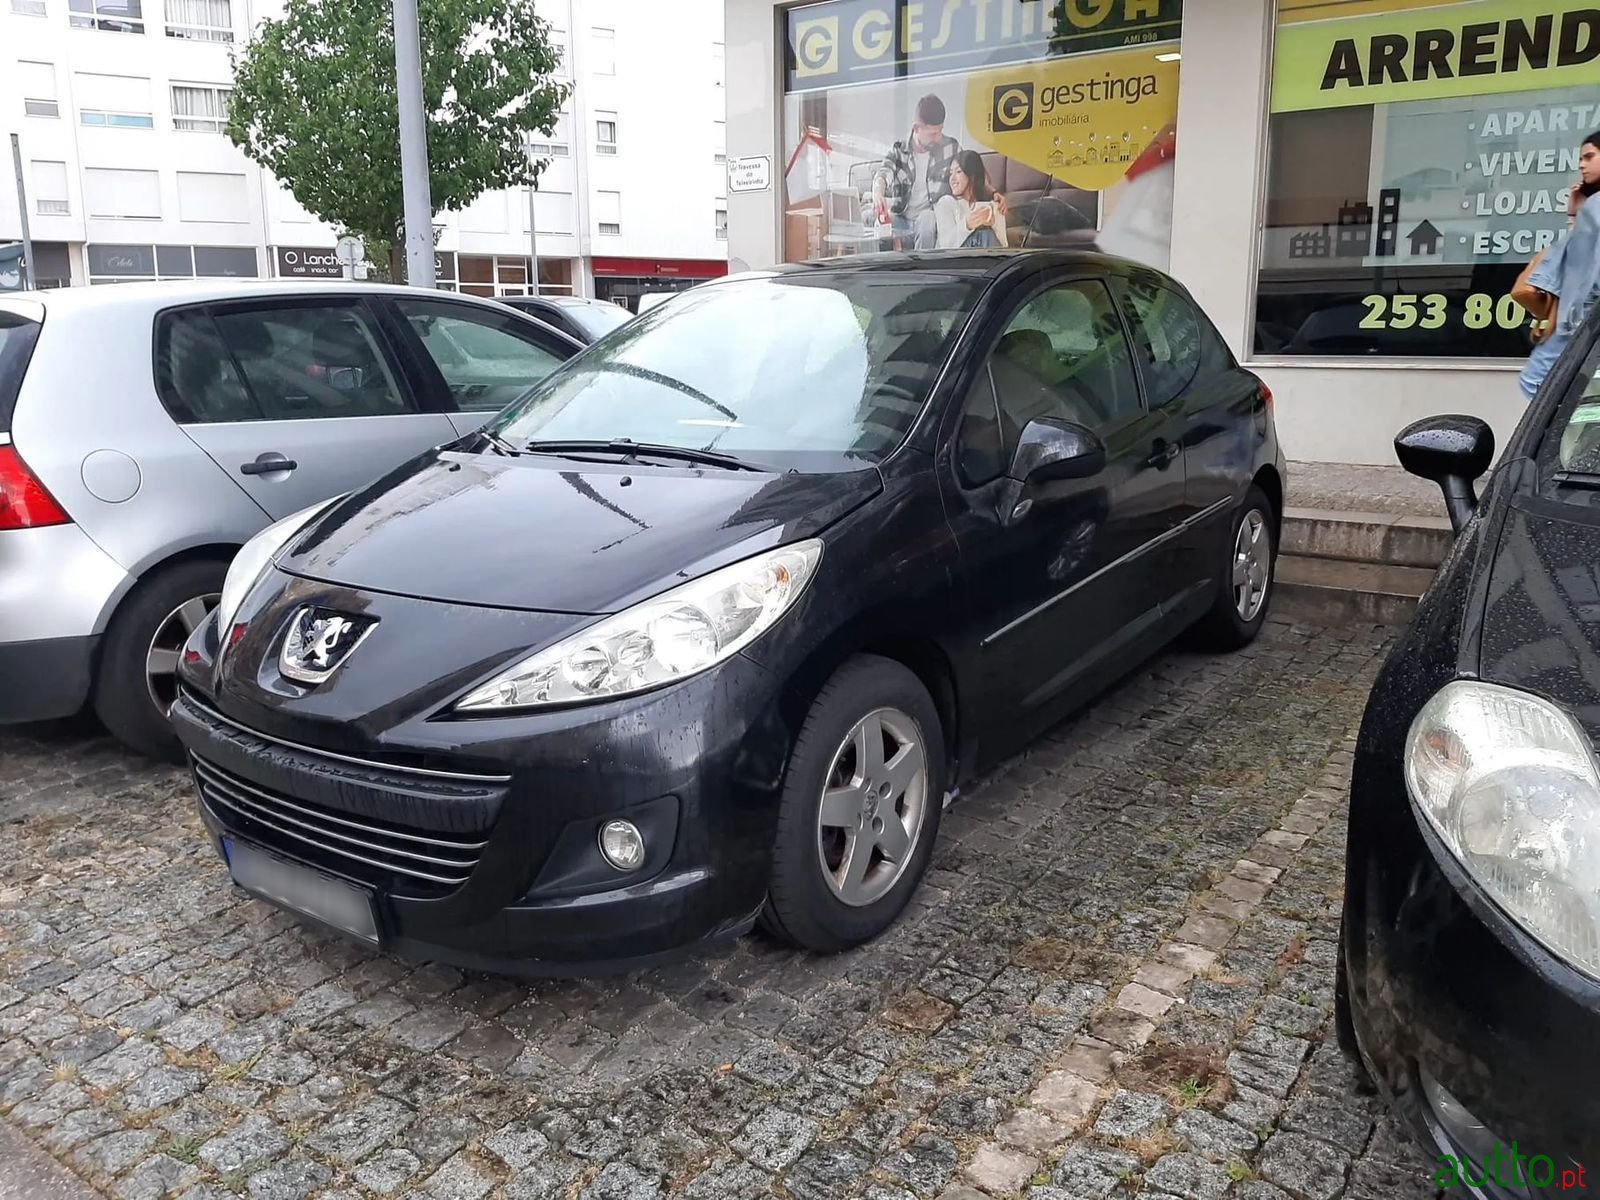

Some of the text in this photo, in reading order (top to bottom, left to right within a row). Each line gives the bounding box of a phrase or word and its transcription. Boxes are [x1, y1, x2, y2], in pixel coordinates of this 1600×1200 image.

[1123, 34, 1141, 45] AMI
[1319, 8, 1600, 91] ARREND
[1040, 72, 1159, 114] gestinga
[1038, 113, 1090, 128] imobiliária
[1476, 187, 1571, 216] LOJAS
[285, 251, 298, 265] O
[1359, 293, 1448, 329] 253
